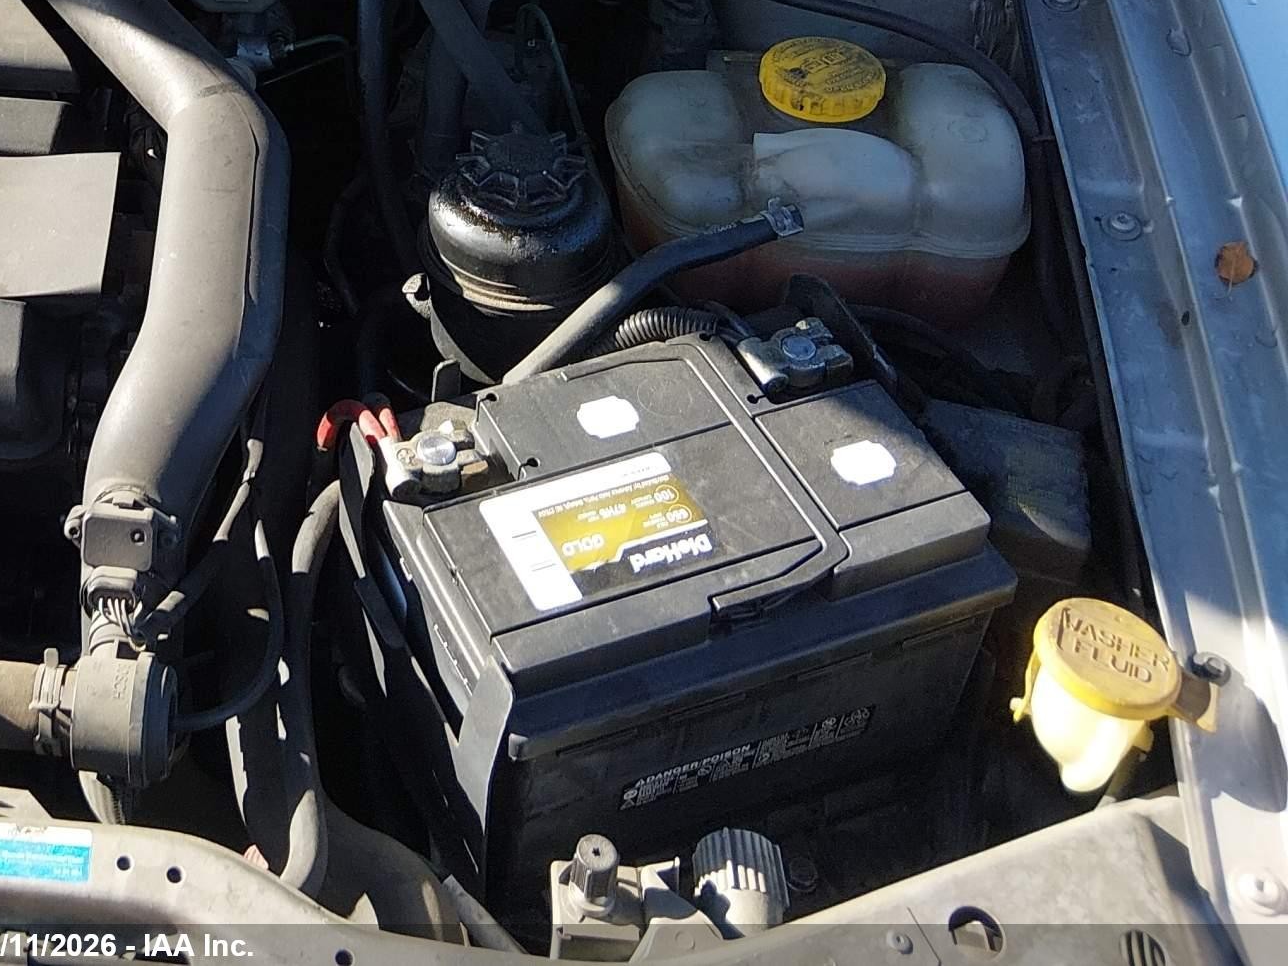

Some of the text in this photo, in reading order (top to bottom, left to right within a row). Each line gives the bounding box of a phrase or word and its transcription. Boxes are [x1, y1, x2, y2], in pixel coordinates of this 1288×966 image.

[653, 488, 675, 503] 100
[562, 534, 604, 557] GOLD
[629, 533, 713, 574] DieHard
[1062, 606, 1171, 672] WASHER
[1074, 637, 1153, 684] FLUID
